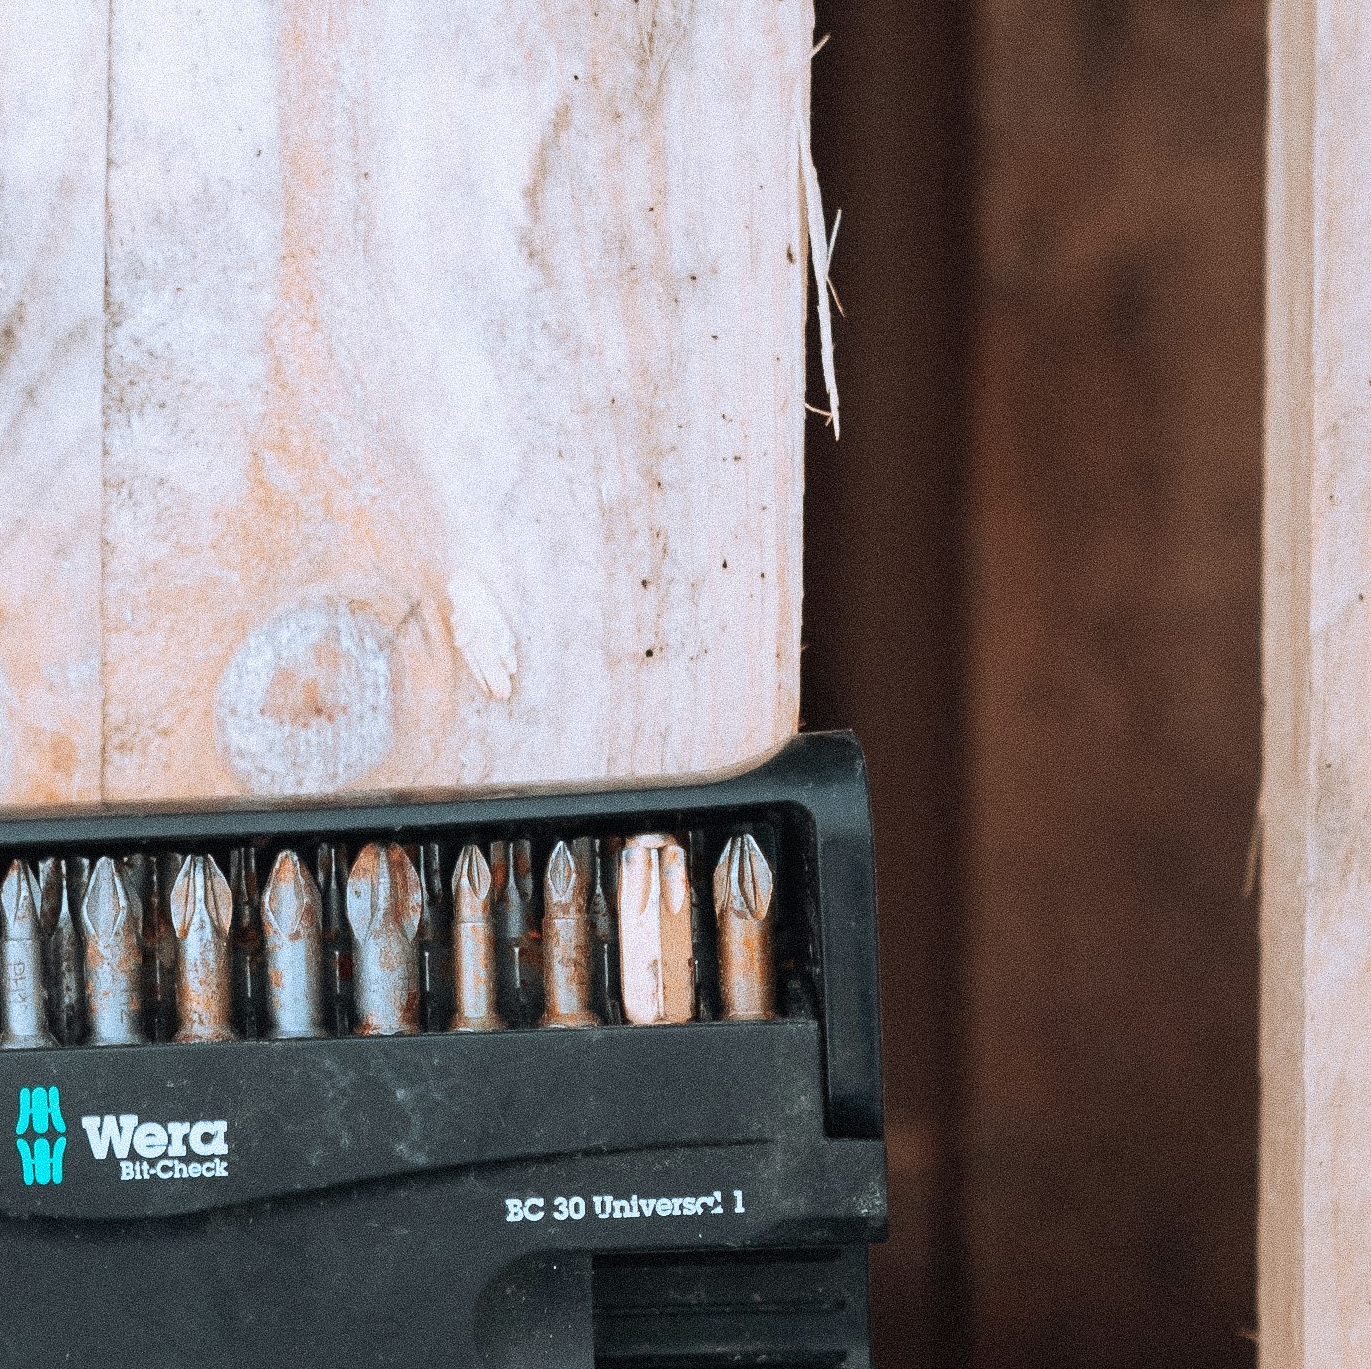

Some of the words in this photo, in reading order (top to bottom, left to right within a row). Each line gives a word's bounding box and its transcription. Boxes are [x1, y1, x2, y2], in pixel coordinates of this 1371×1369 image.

[81, 1114, 228, 1160] Wera
[119, 1158, 229, 1181] Bit-Check
[505, 1197, 545, 1222] BC
[553, 1196, 586, 1221] 30
[733, 1189, 746, 1214] 1
